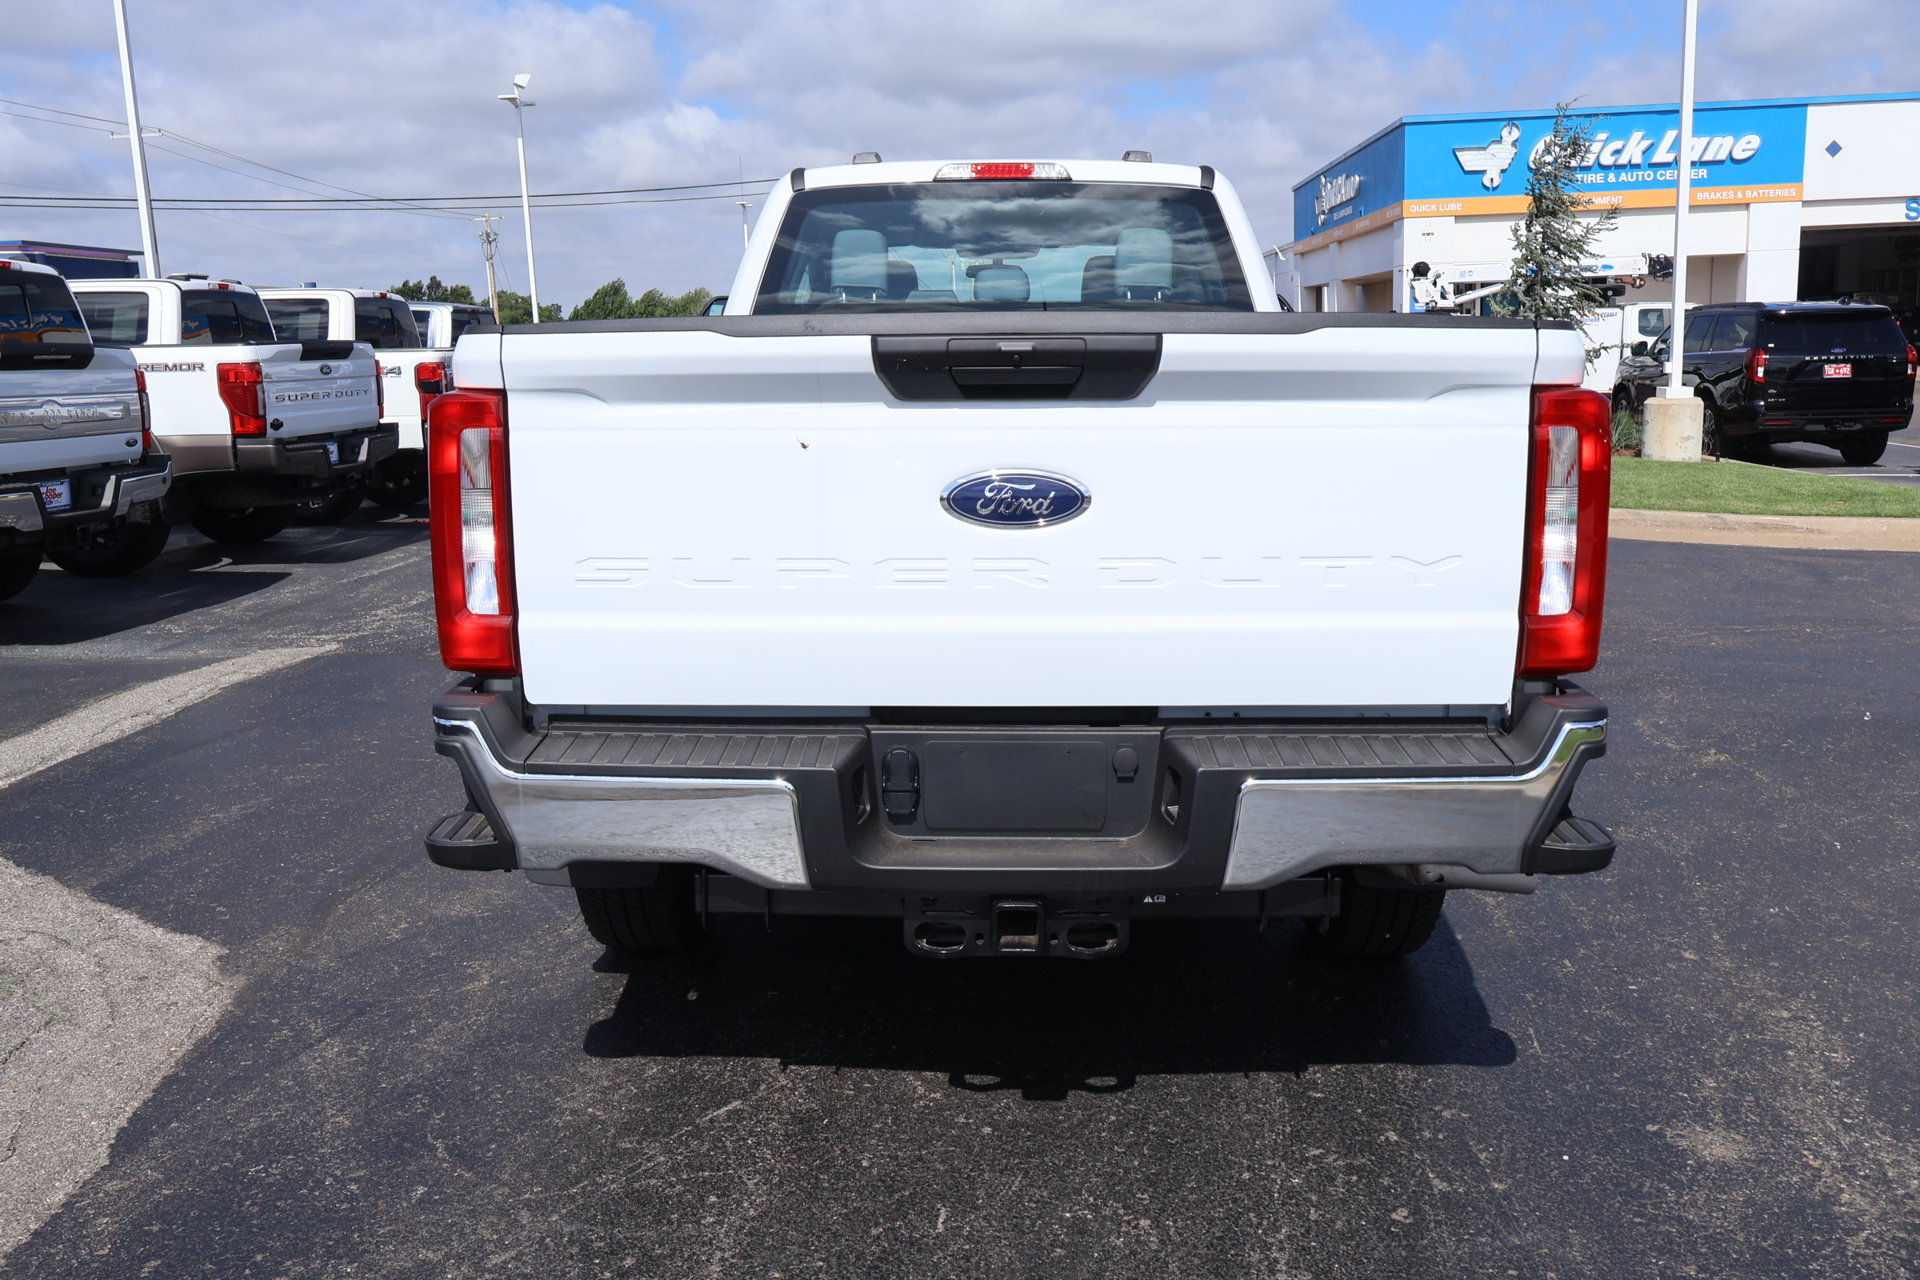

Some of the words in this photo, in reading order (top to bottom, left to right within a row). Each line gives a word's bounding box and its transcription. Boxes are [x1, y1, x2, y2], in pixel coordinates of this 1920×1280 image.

[1528, 130, 1654, 170] Qick
[1575, 173, 1604, 184] TIRE
[1608, 172, 1617, 183] &
[1618, 171, 1655, 183] AUTO
[1656, 168, 1708, 181] CEER
[1697, 191, 1734, 200] BRAKES
[1737, 190, 1743, 199] &
[1745, 188, 1796, 198] BATTERIES
[1410, 204, 1437, 213] QUICK
[1439, 203, 1463, 211] LUBE
[138, 362, 206, 373] REMOR
[275, 391, 331, 403] SUPER
[335, 388, 369, 399] DUTY
[976, 481, 1056, 515] Ford
[575, 557, 1051, 589] SUPER
[1098, 555, 1464, 588] DUTY
